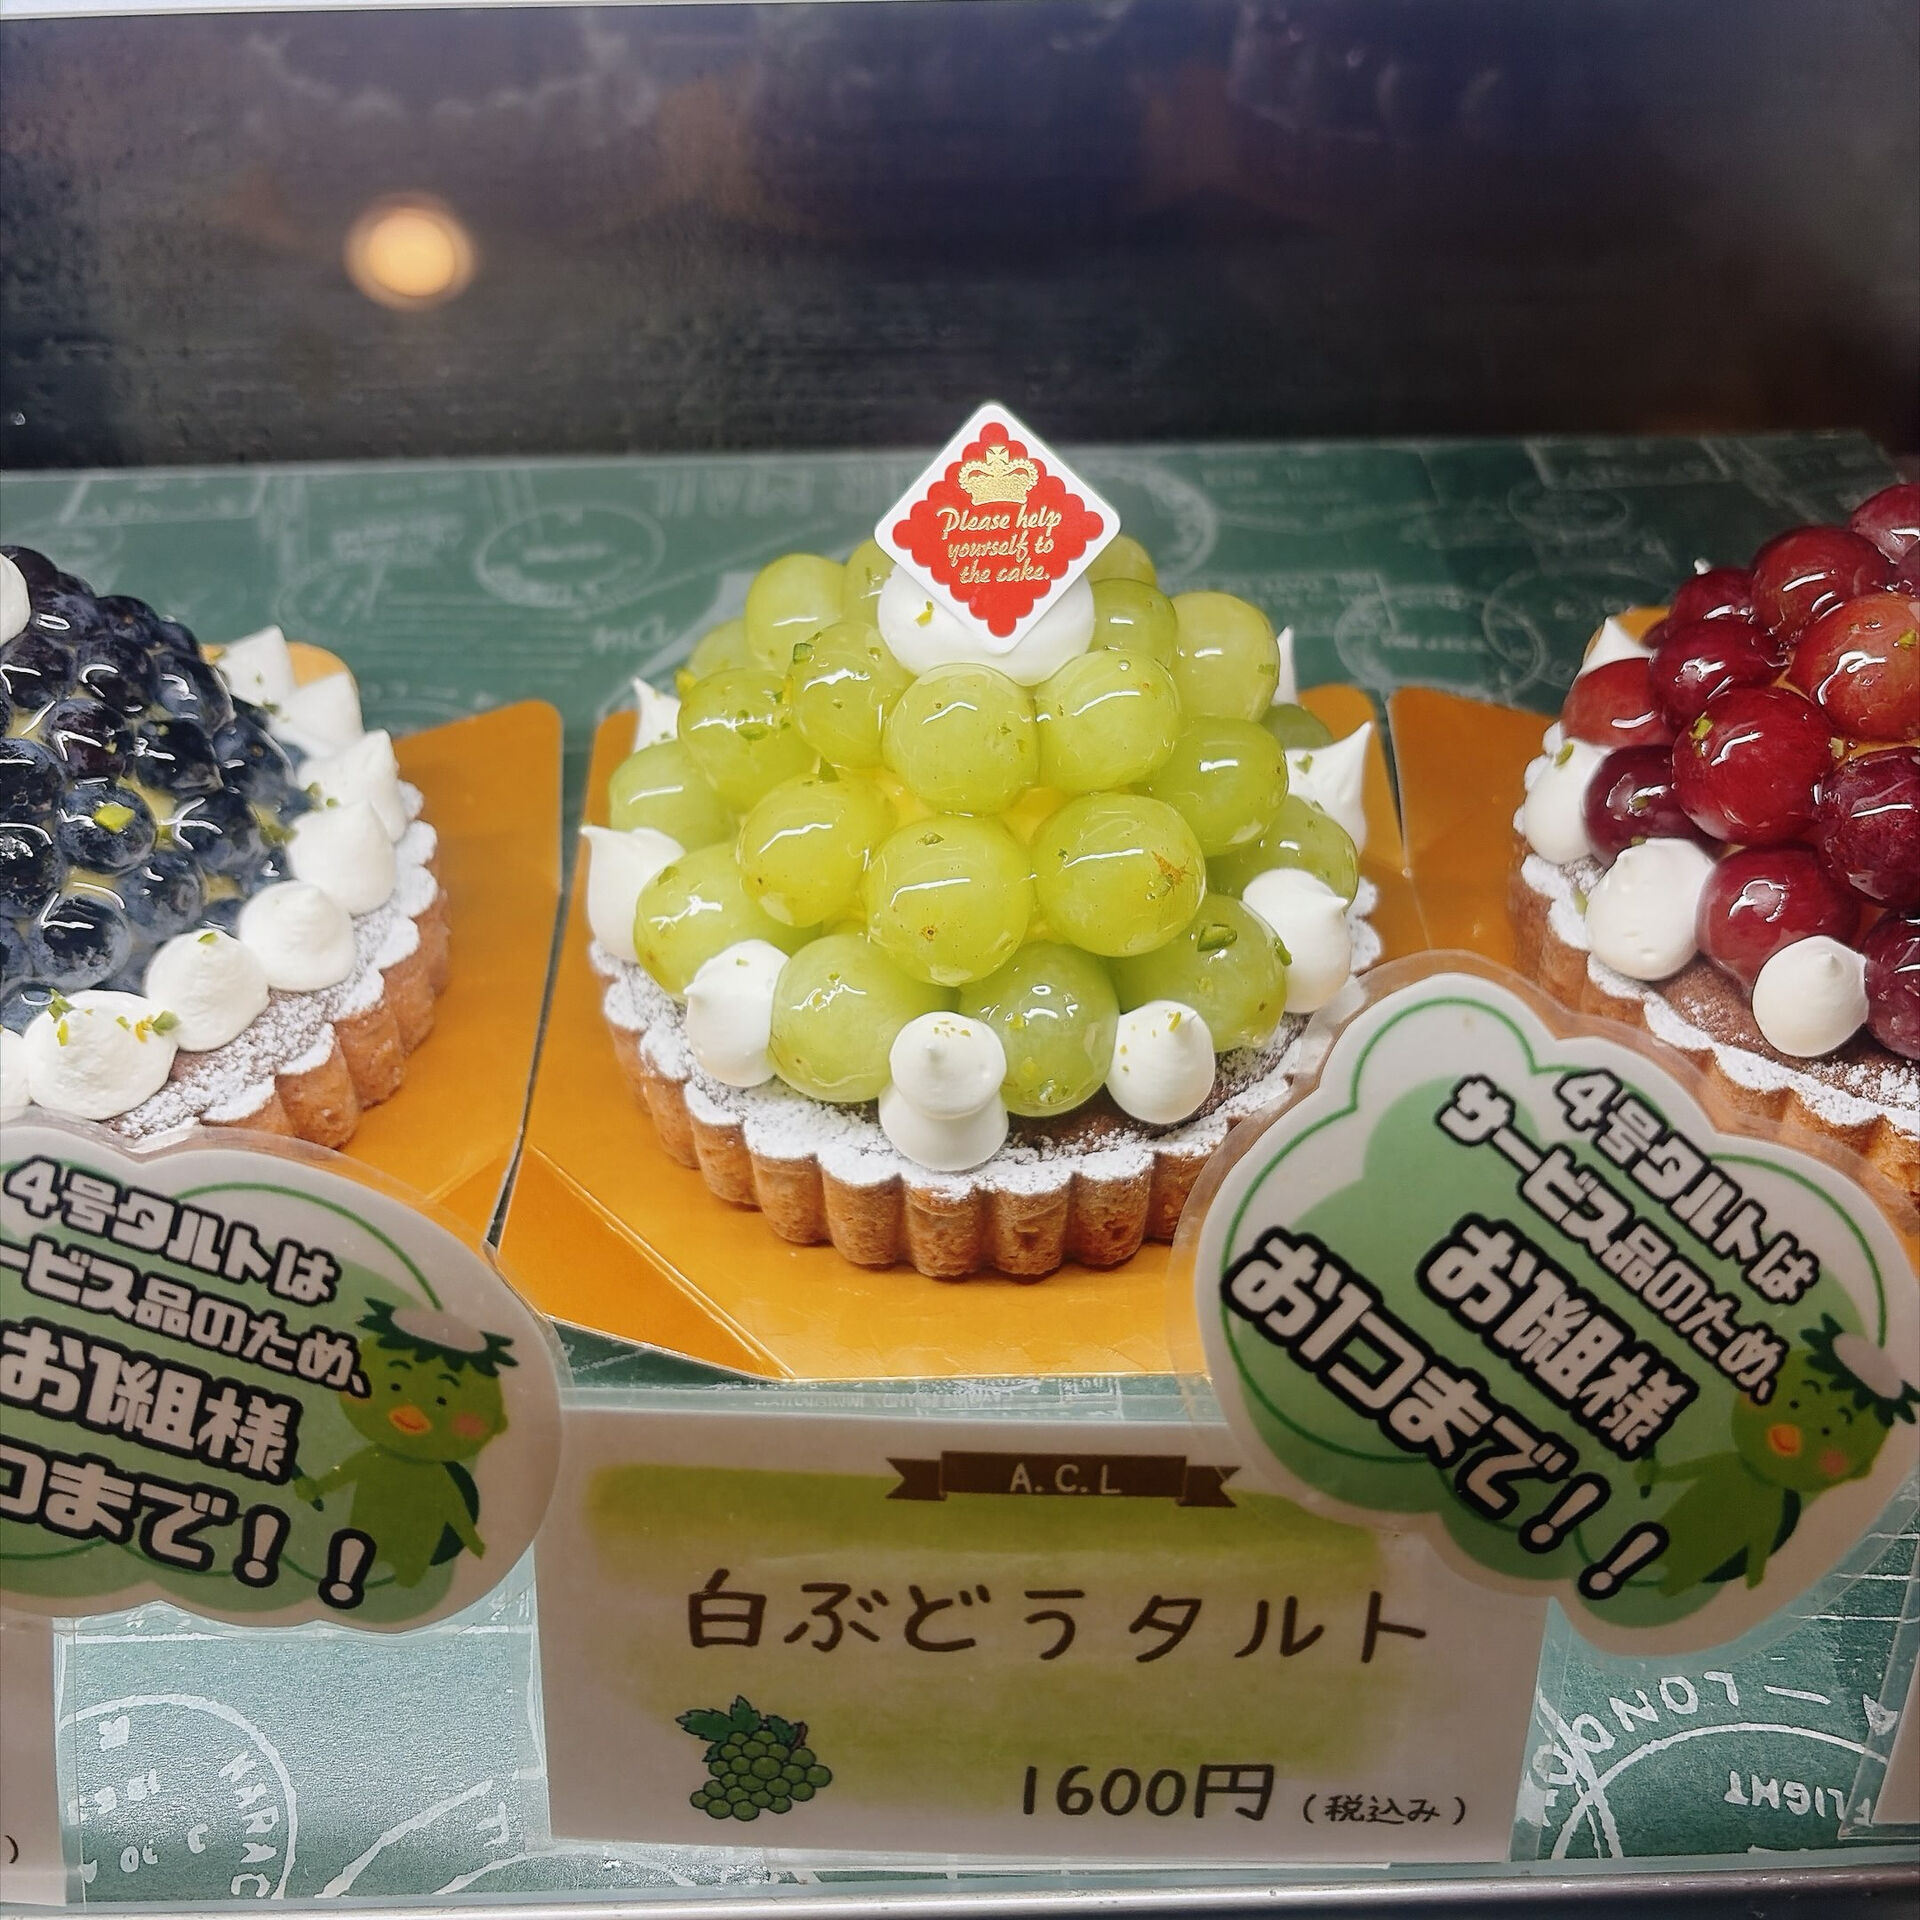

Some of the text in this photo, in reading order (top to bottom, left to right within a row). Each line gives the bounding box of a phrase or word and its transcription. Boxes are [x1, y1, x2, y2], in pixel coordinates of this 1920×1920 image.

[935, 504, 1062, 540] Please help
[947, 530, 1054, 567] yourself to
[959, 558, 1050, 584] the cake.
[1554, 1070, 1818, 1302] 4号タルトは
[5, 1156, 340, 1304] 4号タルトは
[1435, 1074, 1788, 1402] サービス品のため、
[688, 1568, 1427, 1663] 白ぶどうタルト
[1022, 1763, 1275, 1822] 1600円
